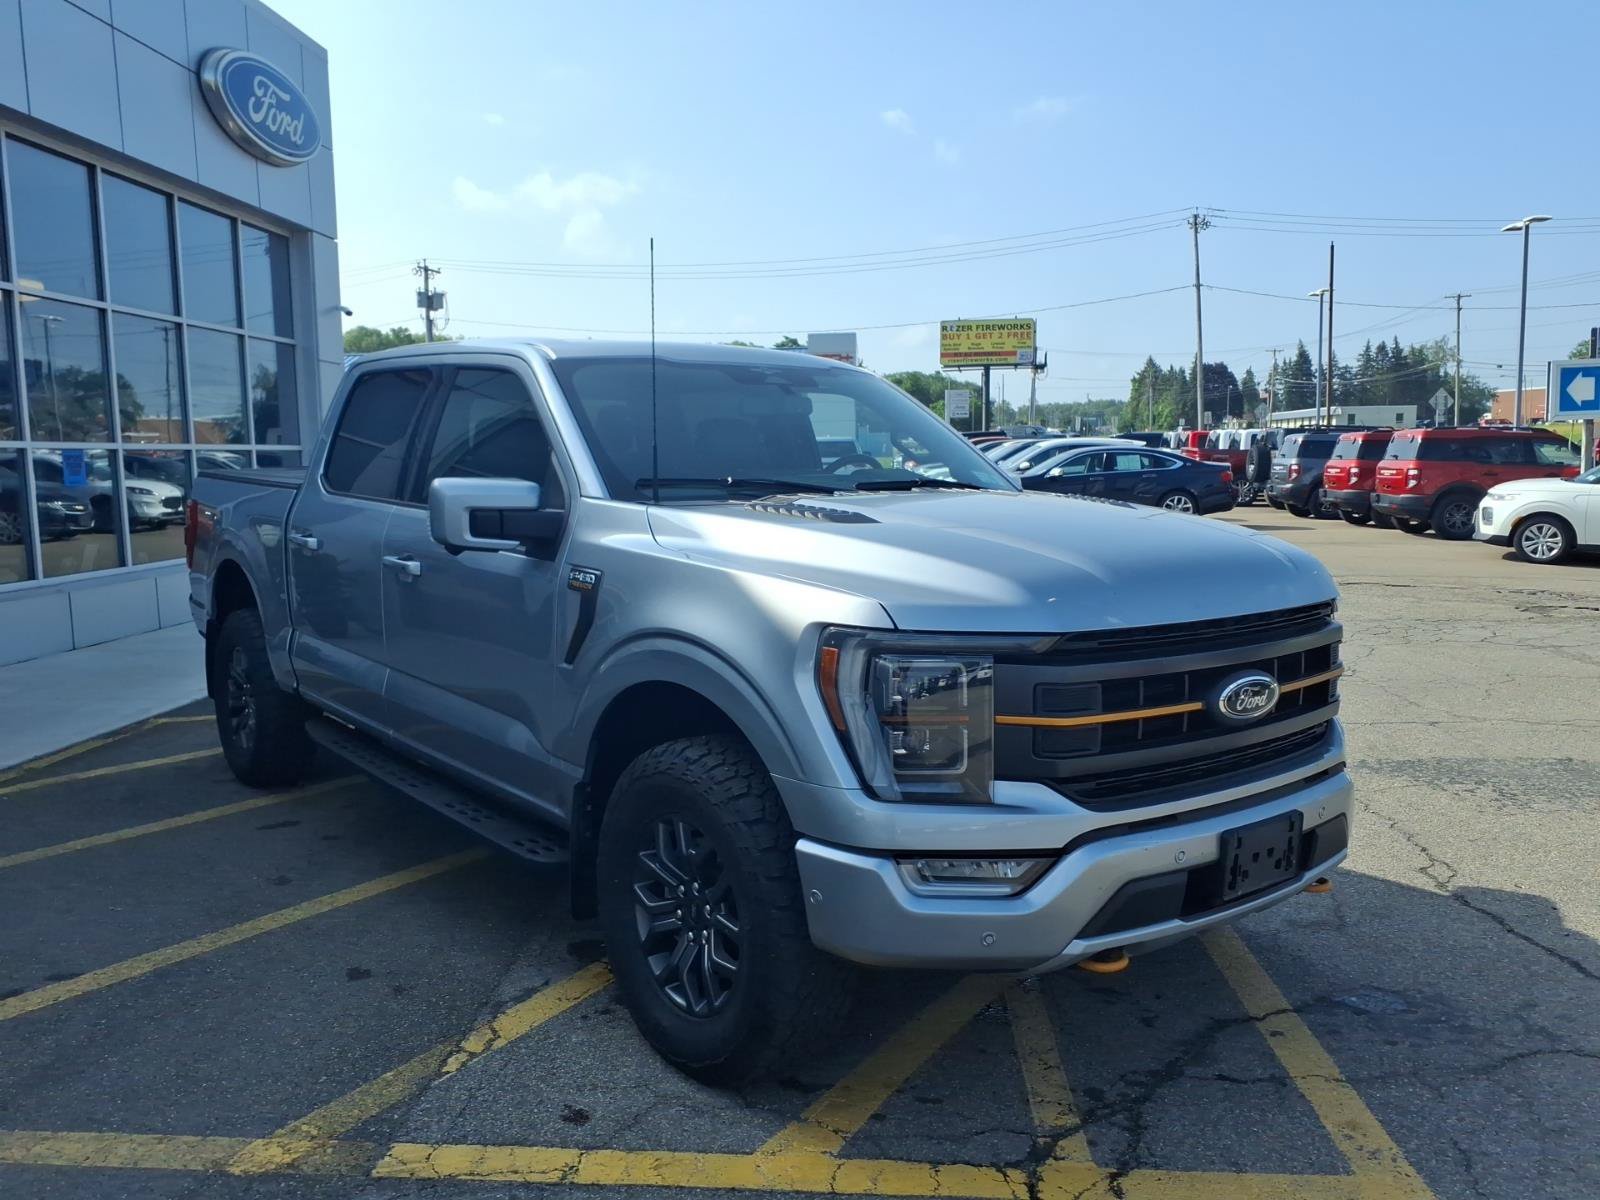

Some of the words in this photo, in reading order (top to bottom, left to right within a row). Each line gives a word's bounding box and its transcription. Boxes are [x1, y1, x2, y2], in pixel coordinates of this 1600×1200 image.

[248, 75, 305, 145] Ford
[975, 323, 1032, 331] FIREWORKS
[942, 333, 962, 341] BUY
[975, 332, 993, 340] GET
[1007, 331, 1032, 340] FREE
[1236, 686, 1269, 711] Ford
